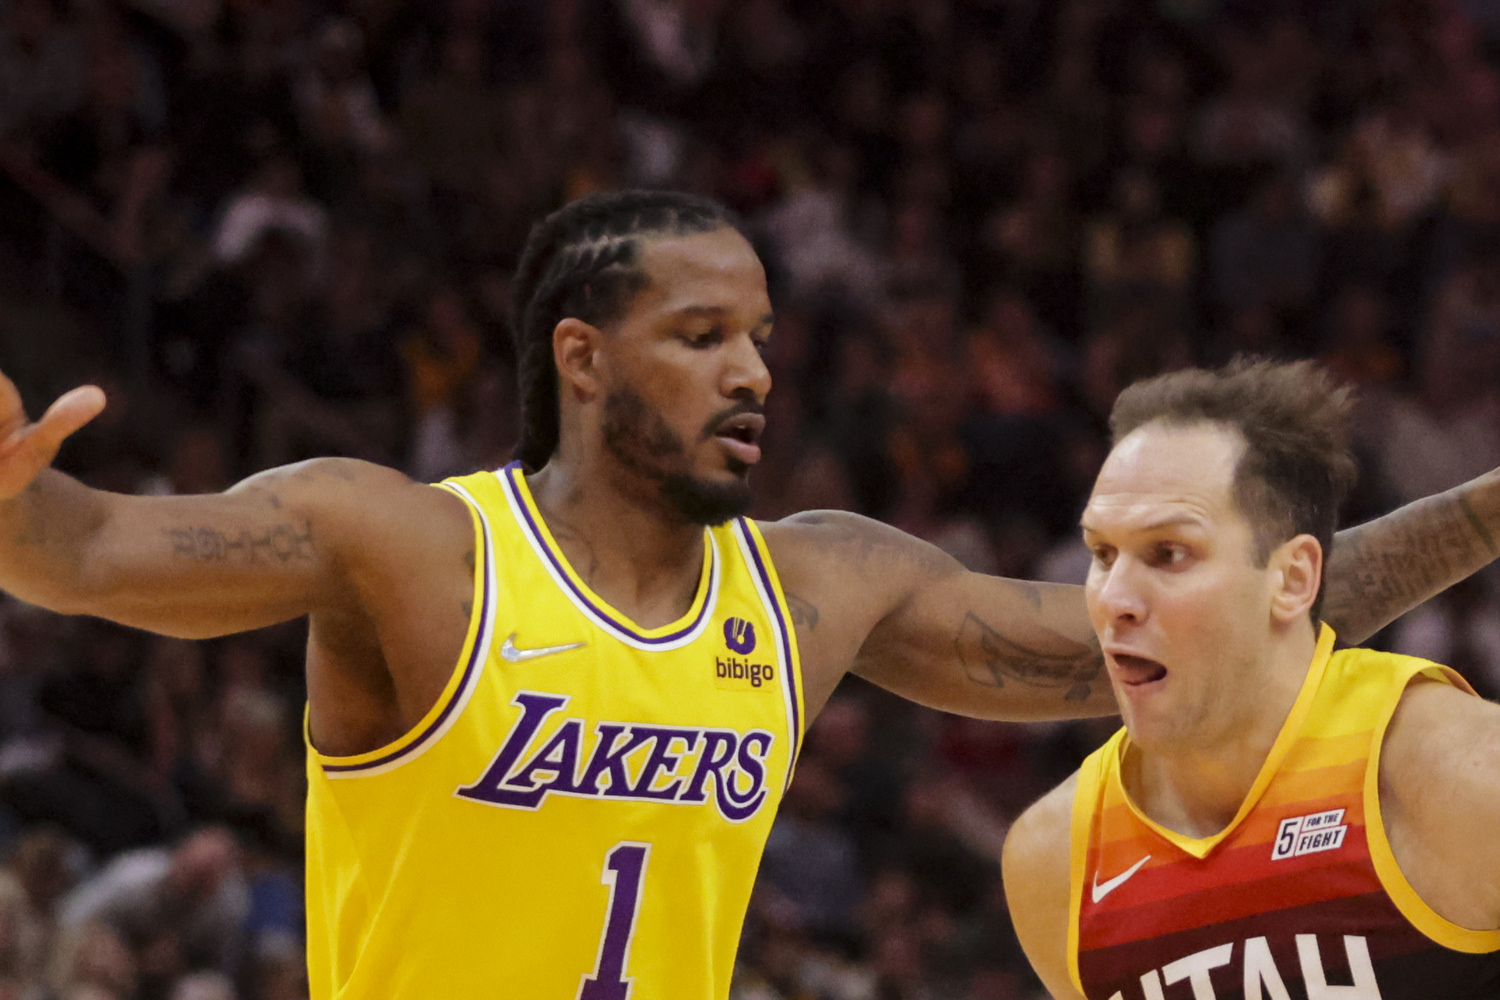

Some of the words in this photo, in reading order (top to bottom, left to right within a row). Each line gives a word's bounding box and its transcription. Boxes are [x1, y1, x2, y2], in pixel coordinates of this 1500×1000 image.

[716, 656, 774, 688] bibigo
[453, 689, 775, 824] LAKERS
[1306, 816, 1322, 827] FOR
[1323, 813, 1339, 824] THE
[1278, 821, 1298, 855] 5
[1299, 830, 1342, 851] FIGHT
